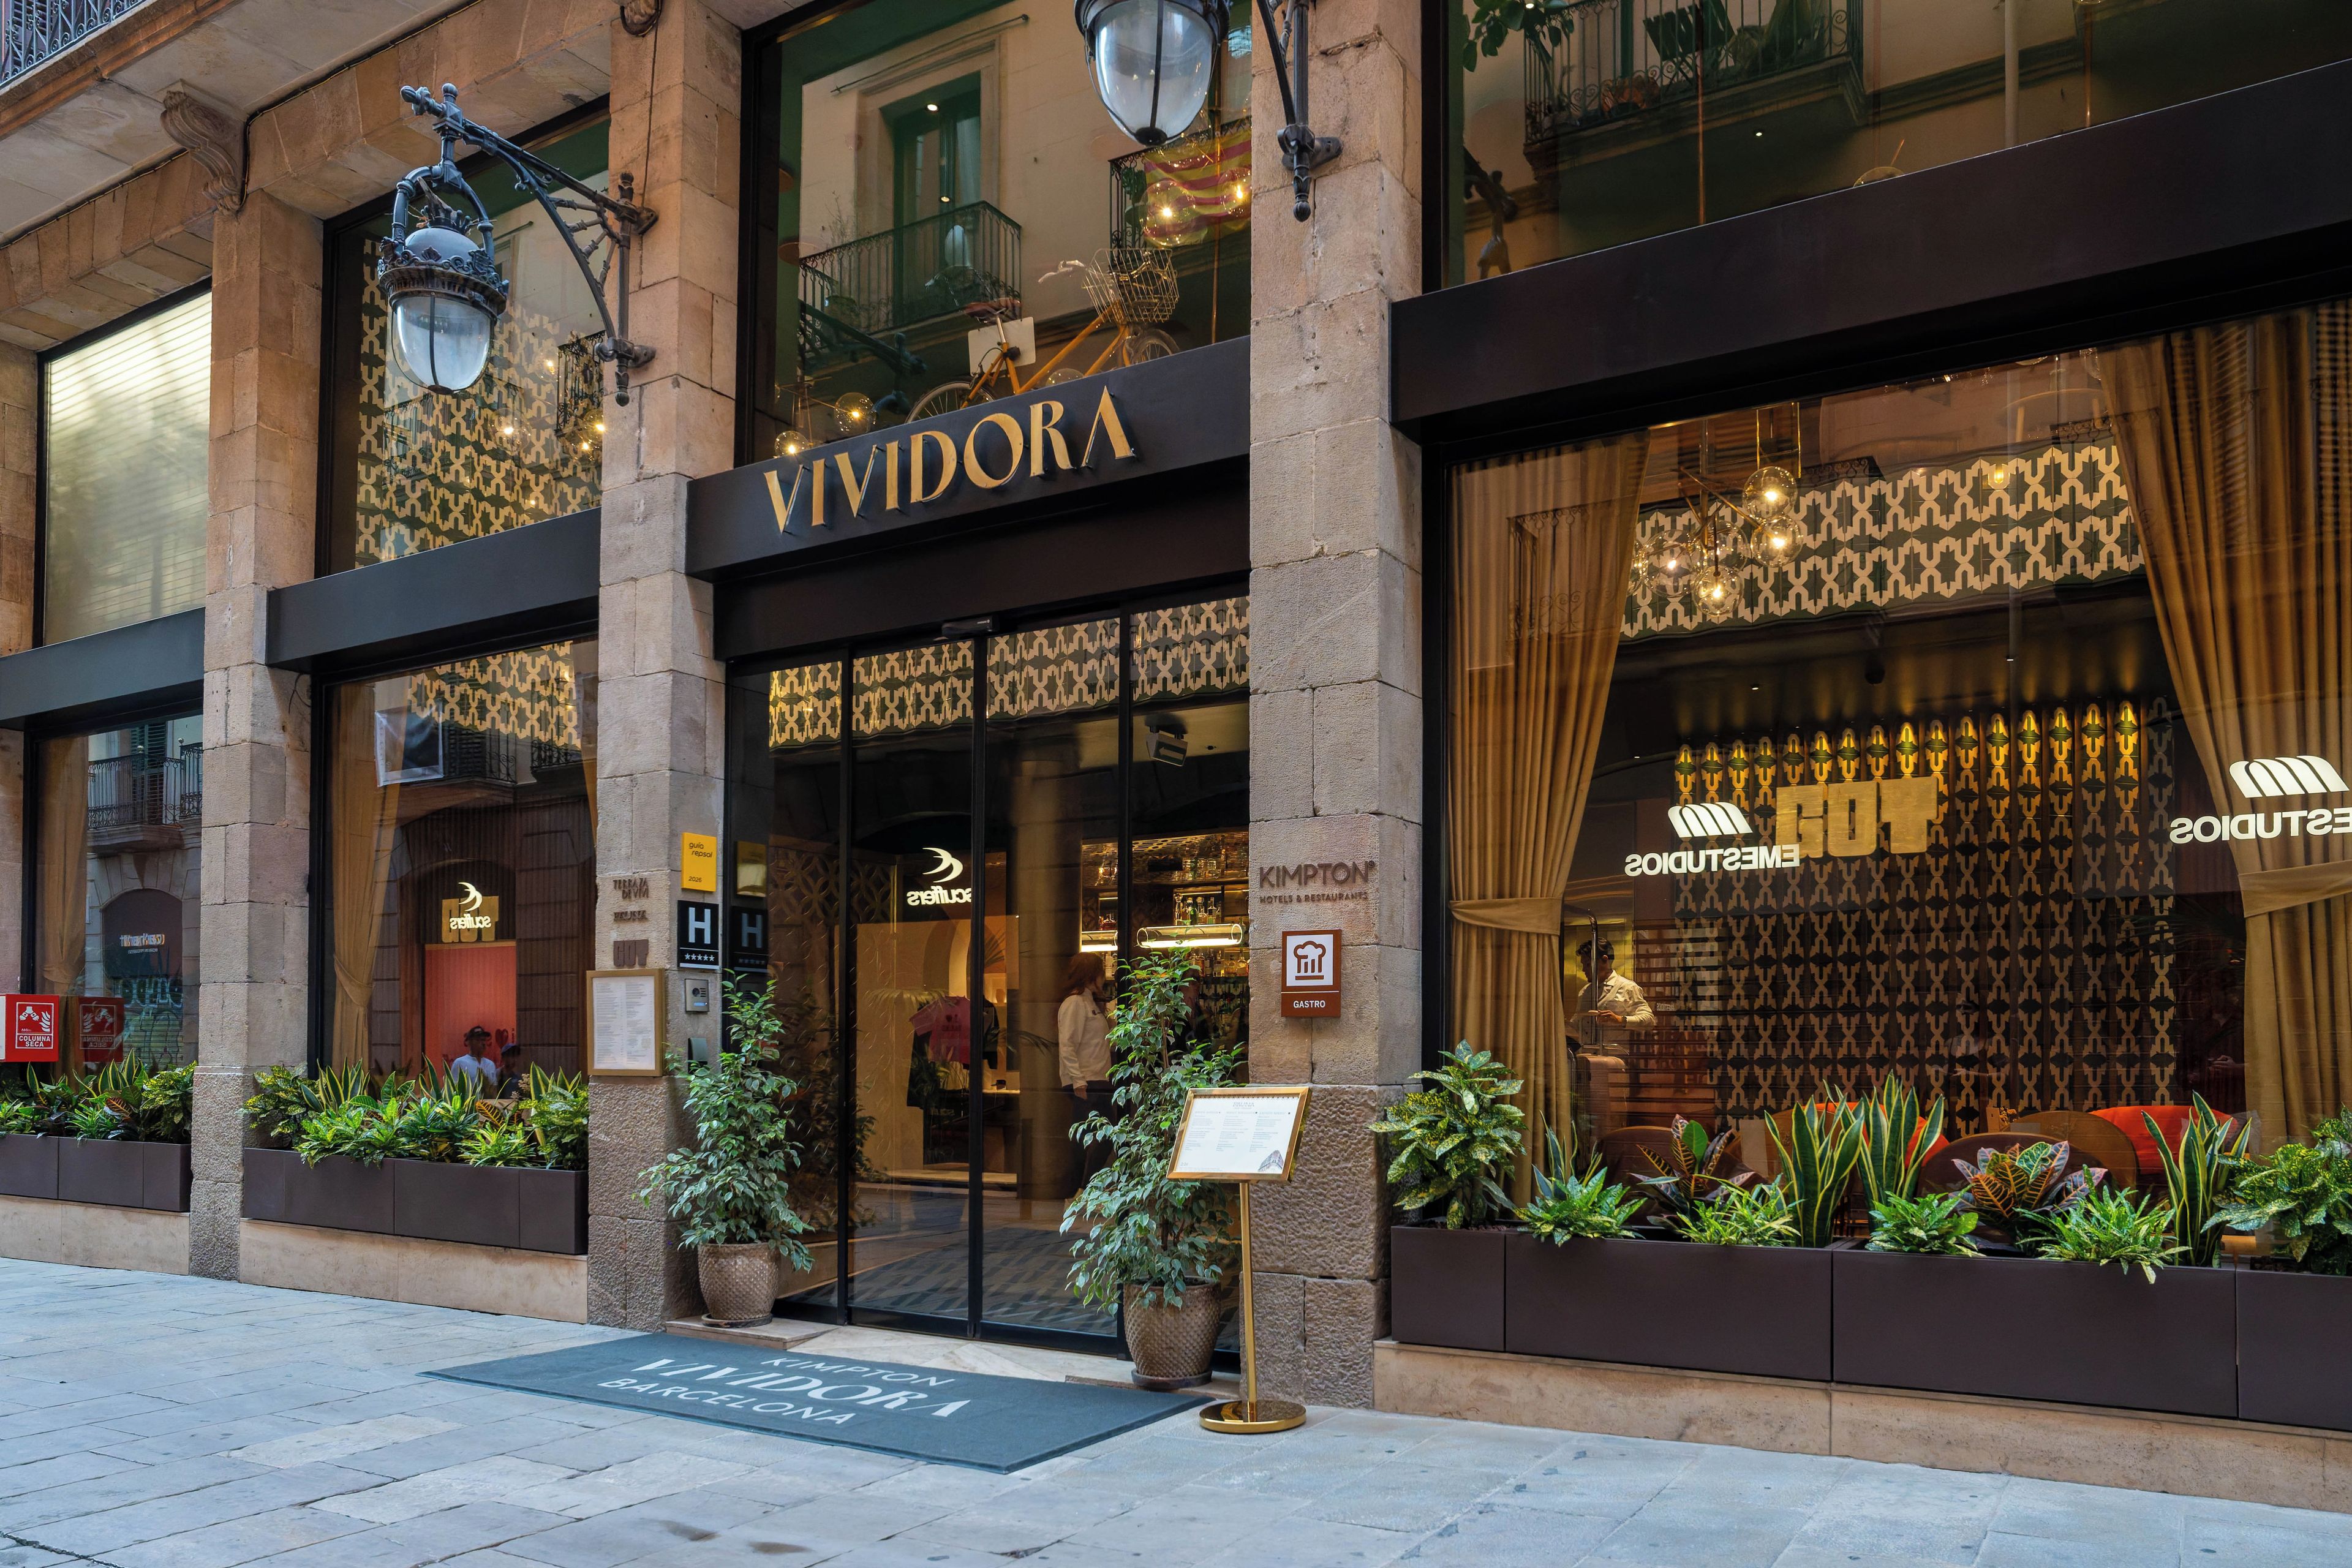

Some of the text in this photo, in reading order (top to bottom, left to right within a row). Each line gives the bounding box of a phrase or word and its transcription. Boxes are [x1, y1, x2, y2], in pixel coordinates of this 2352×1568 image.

[763, 385, 1134, 535] VIVIDORA
[1776, 776, 1937, 858] GOT
[1259, 894, 1293, 904] HOTELS
[1305, 892, 1368, 902] RESTAURANTS
[688, 907, 711, 944] H
[1293, 1000, 1325, 1009] GASTRO
[631, 1359, 971, 1417] VIVIDORA
[760, 1357, 956, 1387] KIMPTON
[597, 1378, 856, 1425] BARCELONA
